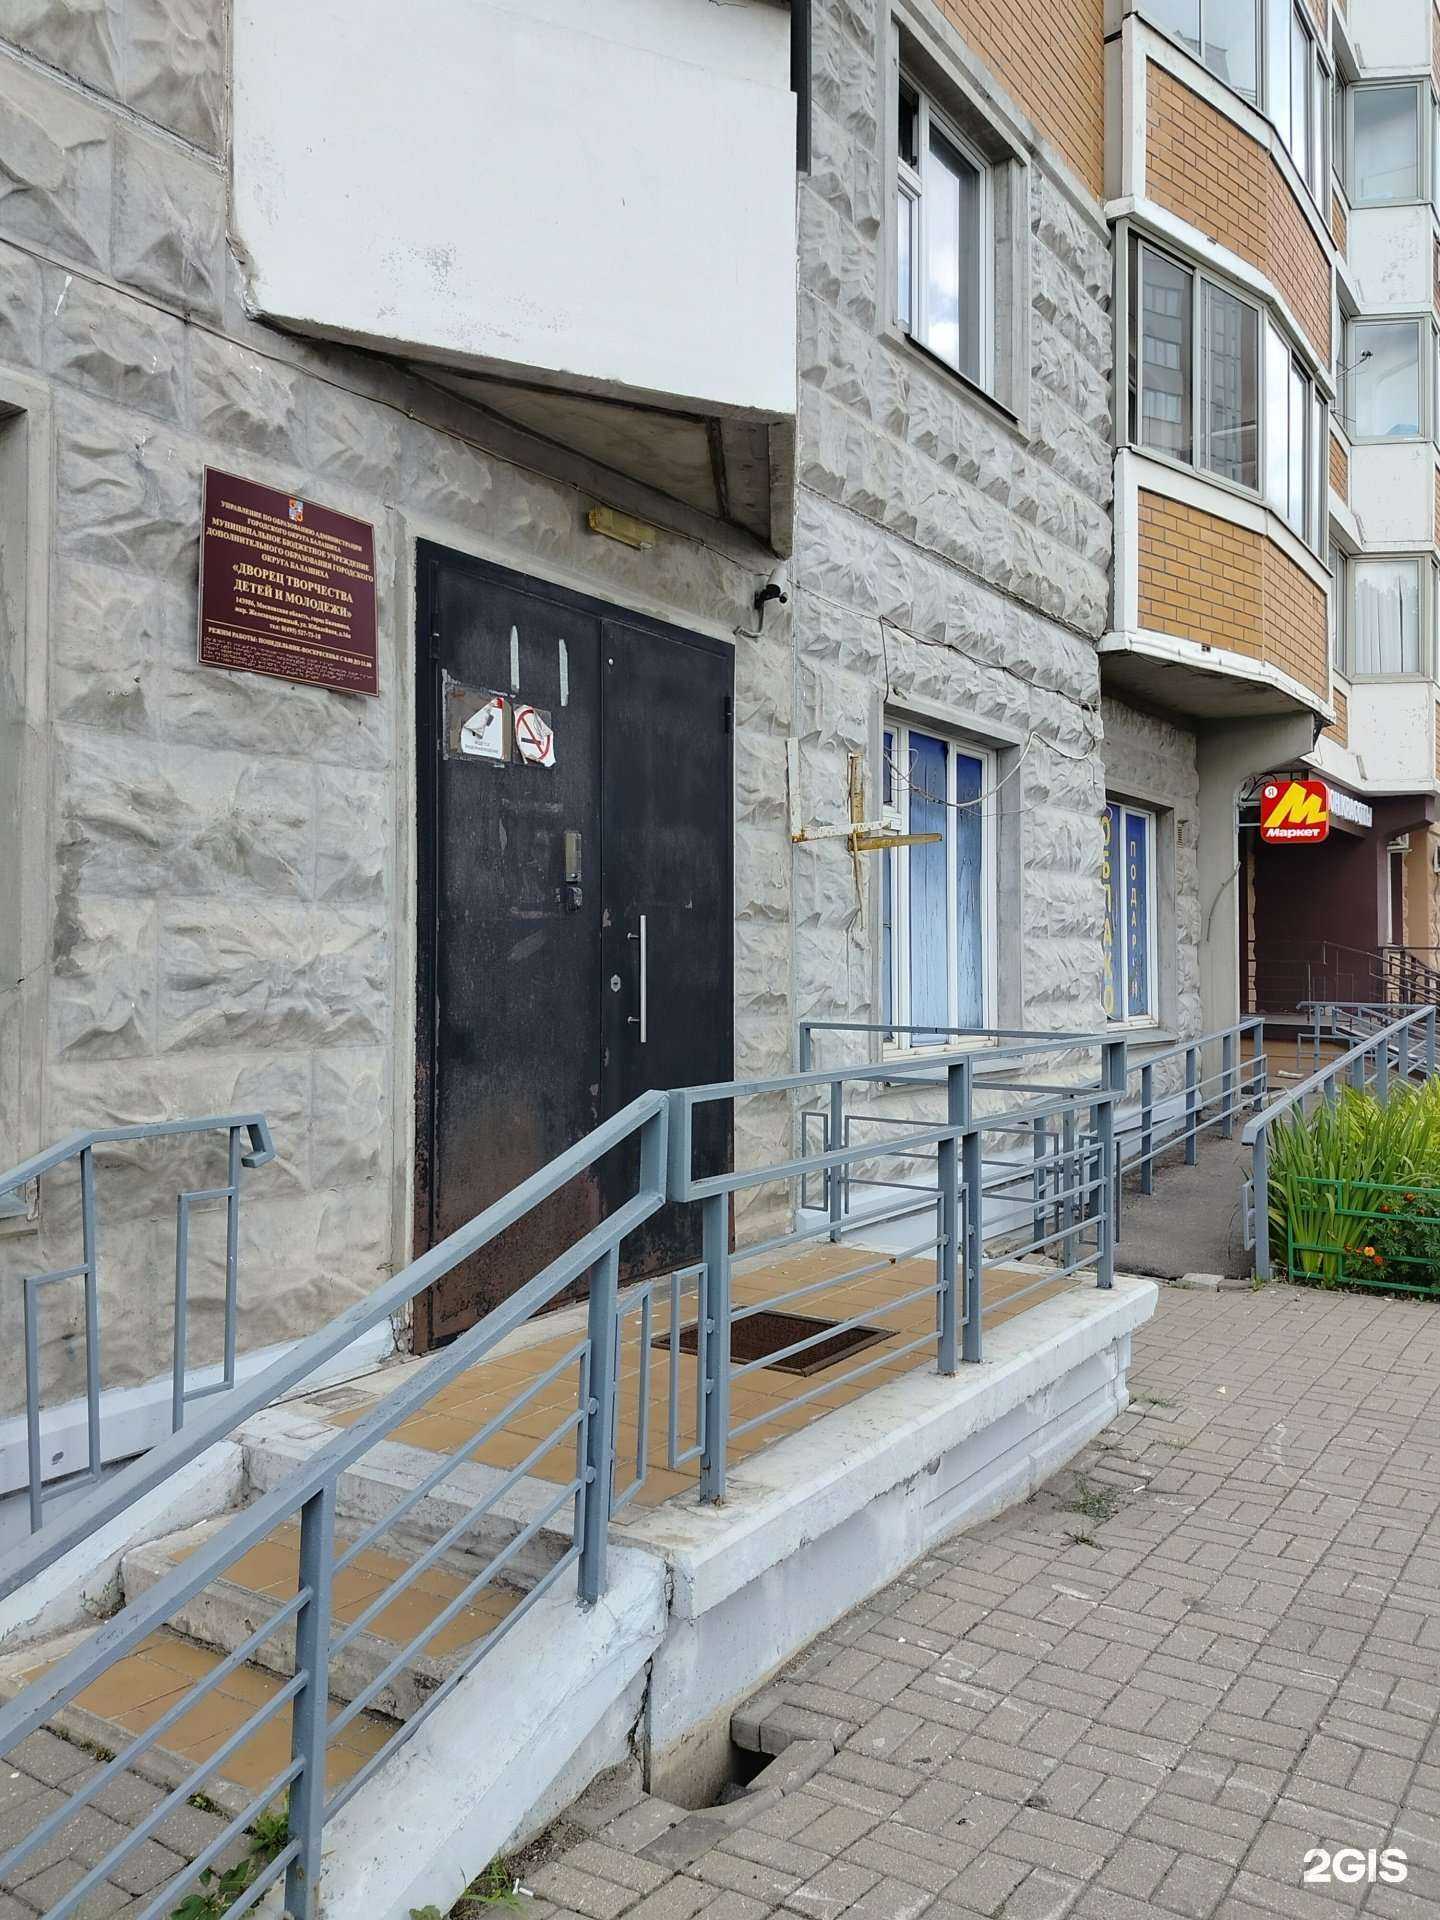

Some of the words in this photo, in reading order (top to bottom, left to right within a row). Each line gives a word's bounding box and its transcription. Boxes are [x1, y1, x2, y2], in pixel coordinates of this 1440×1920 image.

[221, 501, 262, 520] УПРАВЛЕНИЕ
[273, 518, 315, 537] ОБРАЗОВАНИЮ
[248, 518, 287, 536] ГОРОДСКОГО
[288, 531, 309, 543] ОКРУГА
[310, 538, 341, 553] БАЛАШИХА
[206, 526, 284, 557] ДОПОЛНИТЕЛЬНОГО
[285, 550, 331, 571] ОБРАЗОВАНИЯ
[333, 564, 373, 583] ГОРОДСКОГО
[212, 517, 281, 545] МУНИЦИПАЛЬНОЕ
[283, 539, 326, 558] БЮДЖЕТНОЕ
[327, 552, 369, 571] УЧРЕЖДЕНИЕ
[233, 561, 284, 585] «ДВОРЕЦ
[286, 575, 353, 604] ТВОРЧЕСТВА
[262, 554, 289, 568] ОКРУГА
[290, 562, 329, 579] БАЛАШИХА
[234, 577, 273, 599] ДЕТЕЙ
[285, 590, 352, 619] МОЛОДЕЖИ»
[208, 627, 231, 638] РЕЖИМ
[1265, 828, 1320, 838] Маркет
